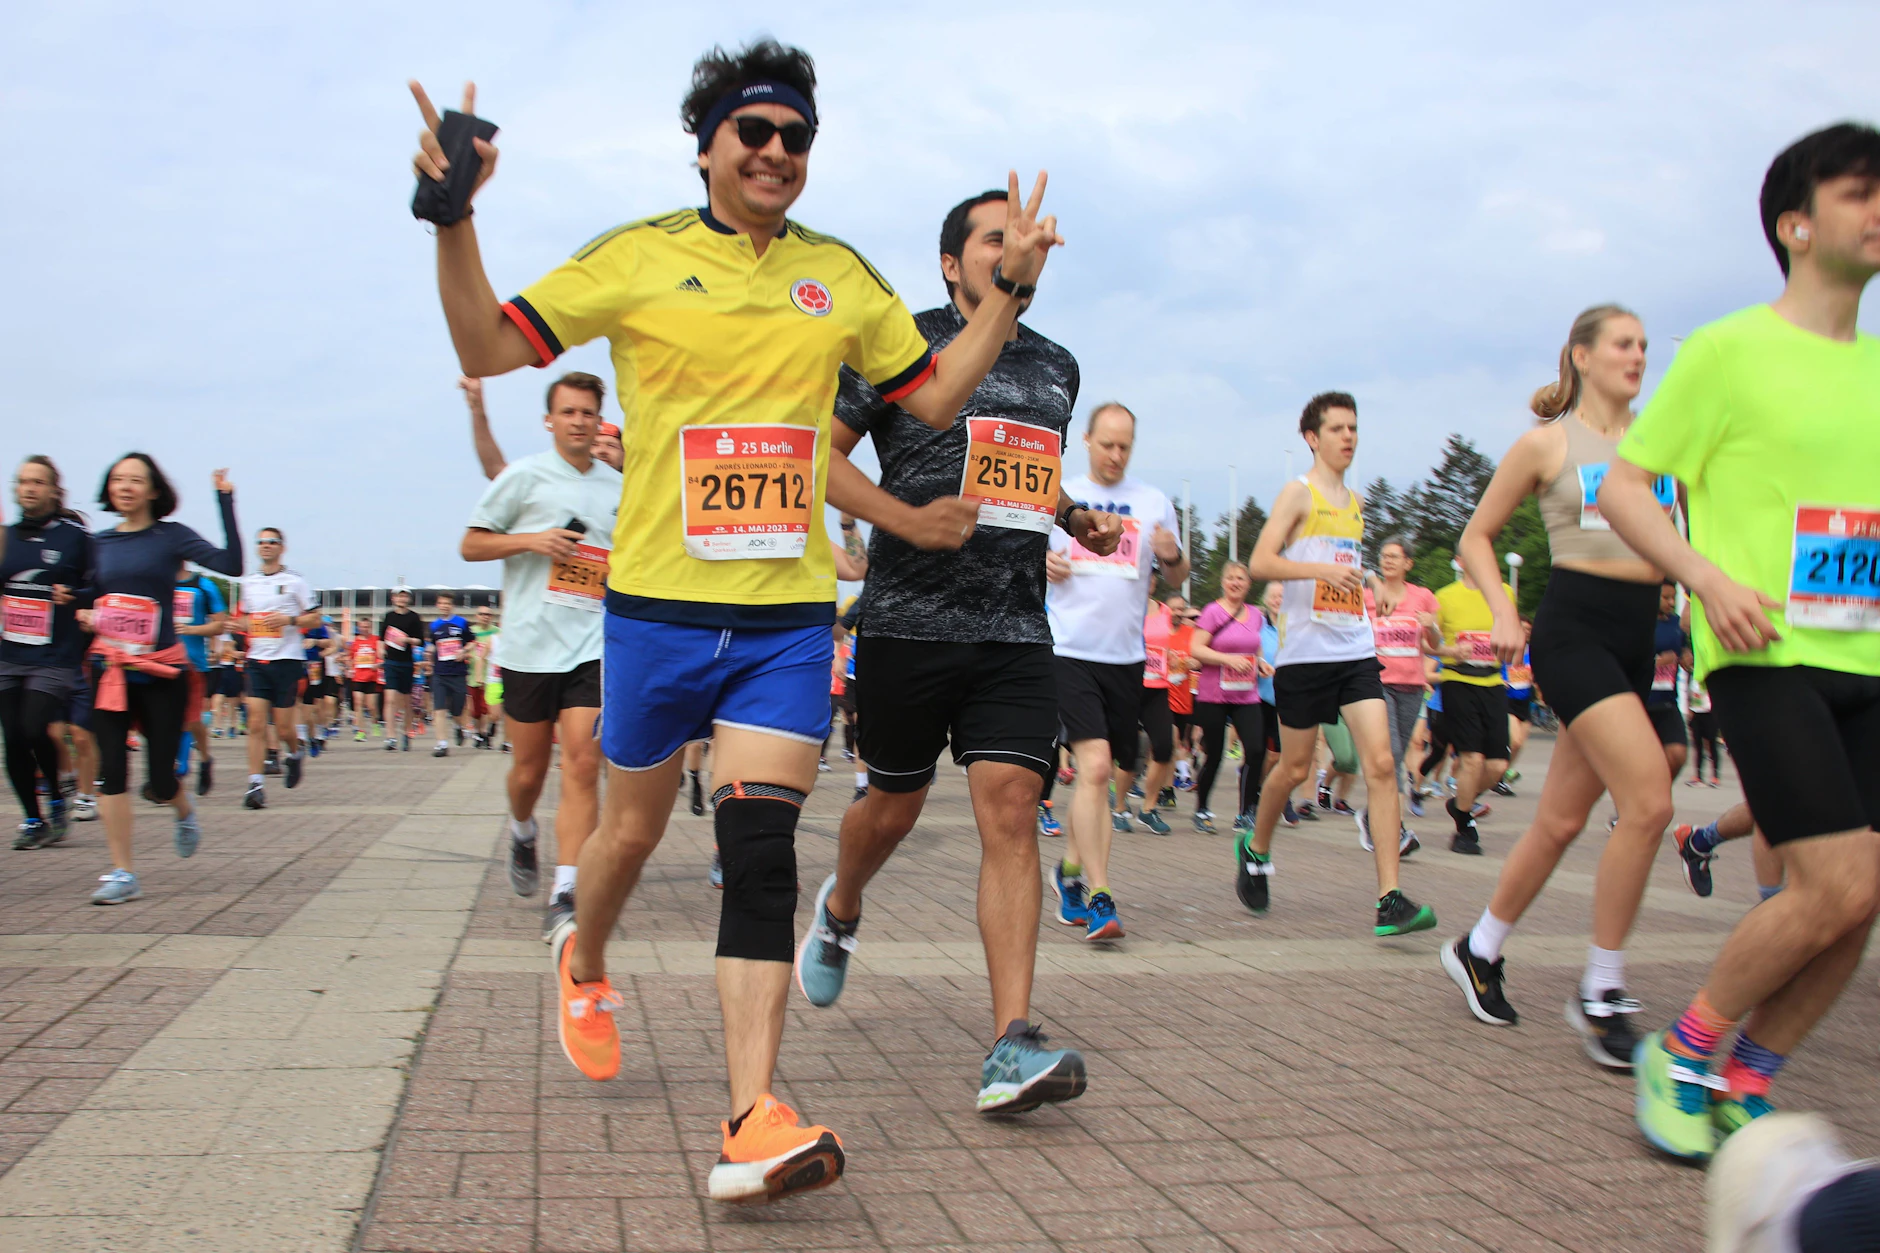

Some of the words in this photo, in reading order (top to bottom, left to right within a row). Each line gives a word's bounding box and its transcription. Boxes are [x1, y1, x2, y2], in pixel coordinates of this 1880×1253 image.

[741, 442, 757, 454] 25
[761, 441, 793, 454] Berlin
[1008, 436, 1019, 446] 25
[1020, 438, 1045, 451] Berlin
[715, 462, 741, 470] ANDRÉS
[742, 462, 777, 470] LEONARDO
[977, 455, 1053, 495] 25157
[701, 472, 807, 511] 26712
[996, 499, 1006, 507] 14.
[1020, 503, 1035, 511] 2023
[1006, 512, 1020, 520] AOK
[732, 525, 746, 533] 14.
[748, 525, 765, 533] MAI
[767, 524, 788, 532] 2023
[747, 539, 767, 547] AOK
